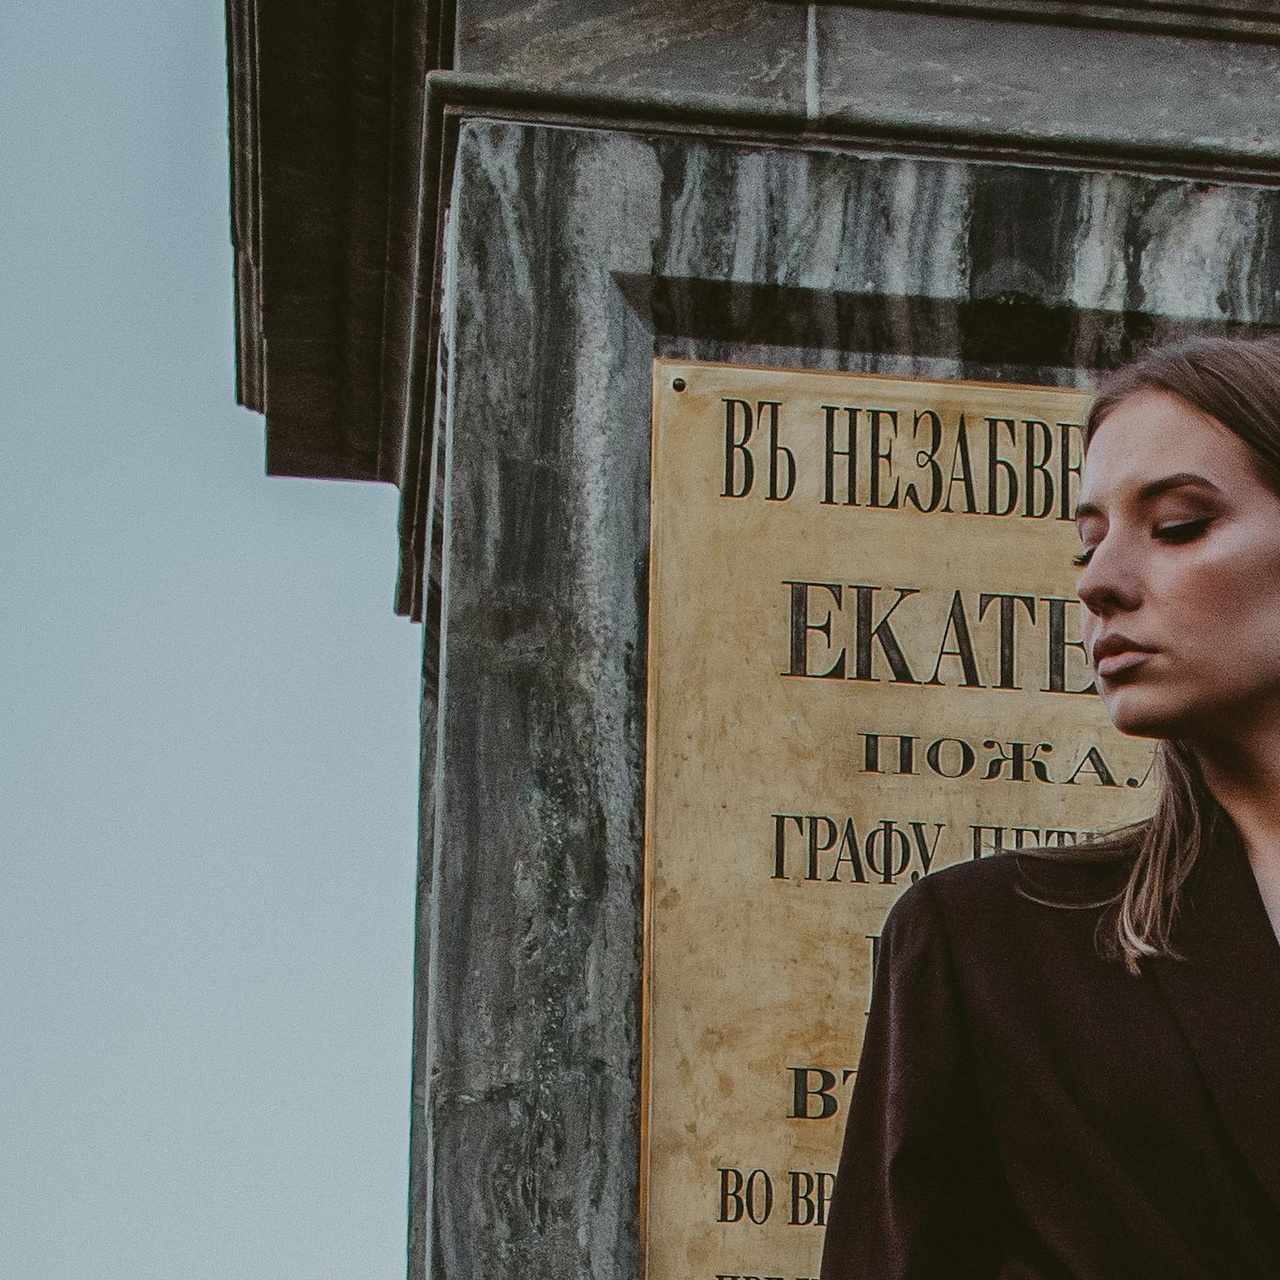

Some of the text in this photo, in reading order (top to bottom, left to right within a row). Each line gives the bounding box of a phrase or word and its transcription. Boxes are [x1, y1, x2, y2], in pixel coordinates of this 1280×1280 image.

[720, 398, 797, 501] ВЪ
[771, 814, 946, 886] ГРАФУ
[716, 1168, 773, 1225] ВО
